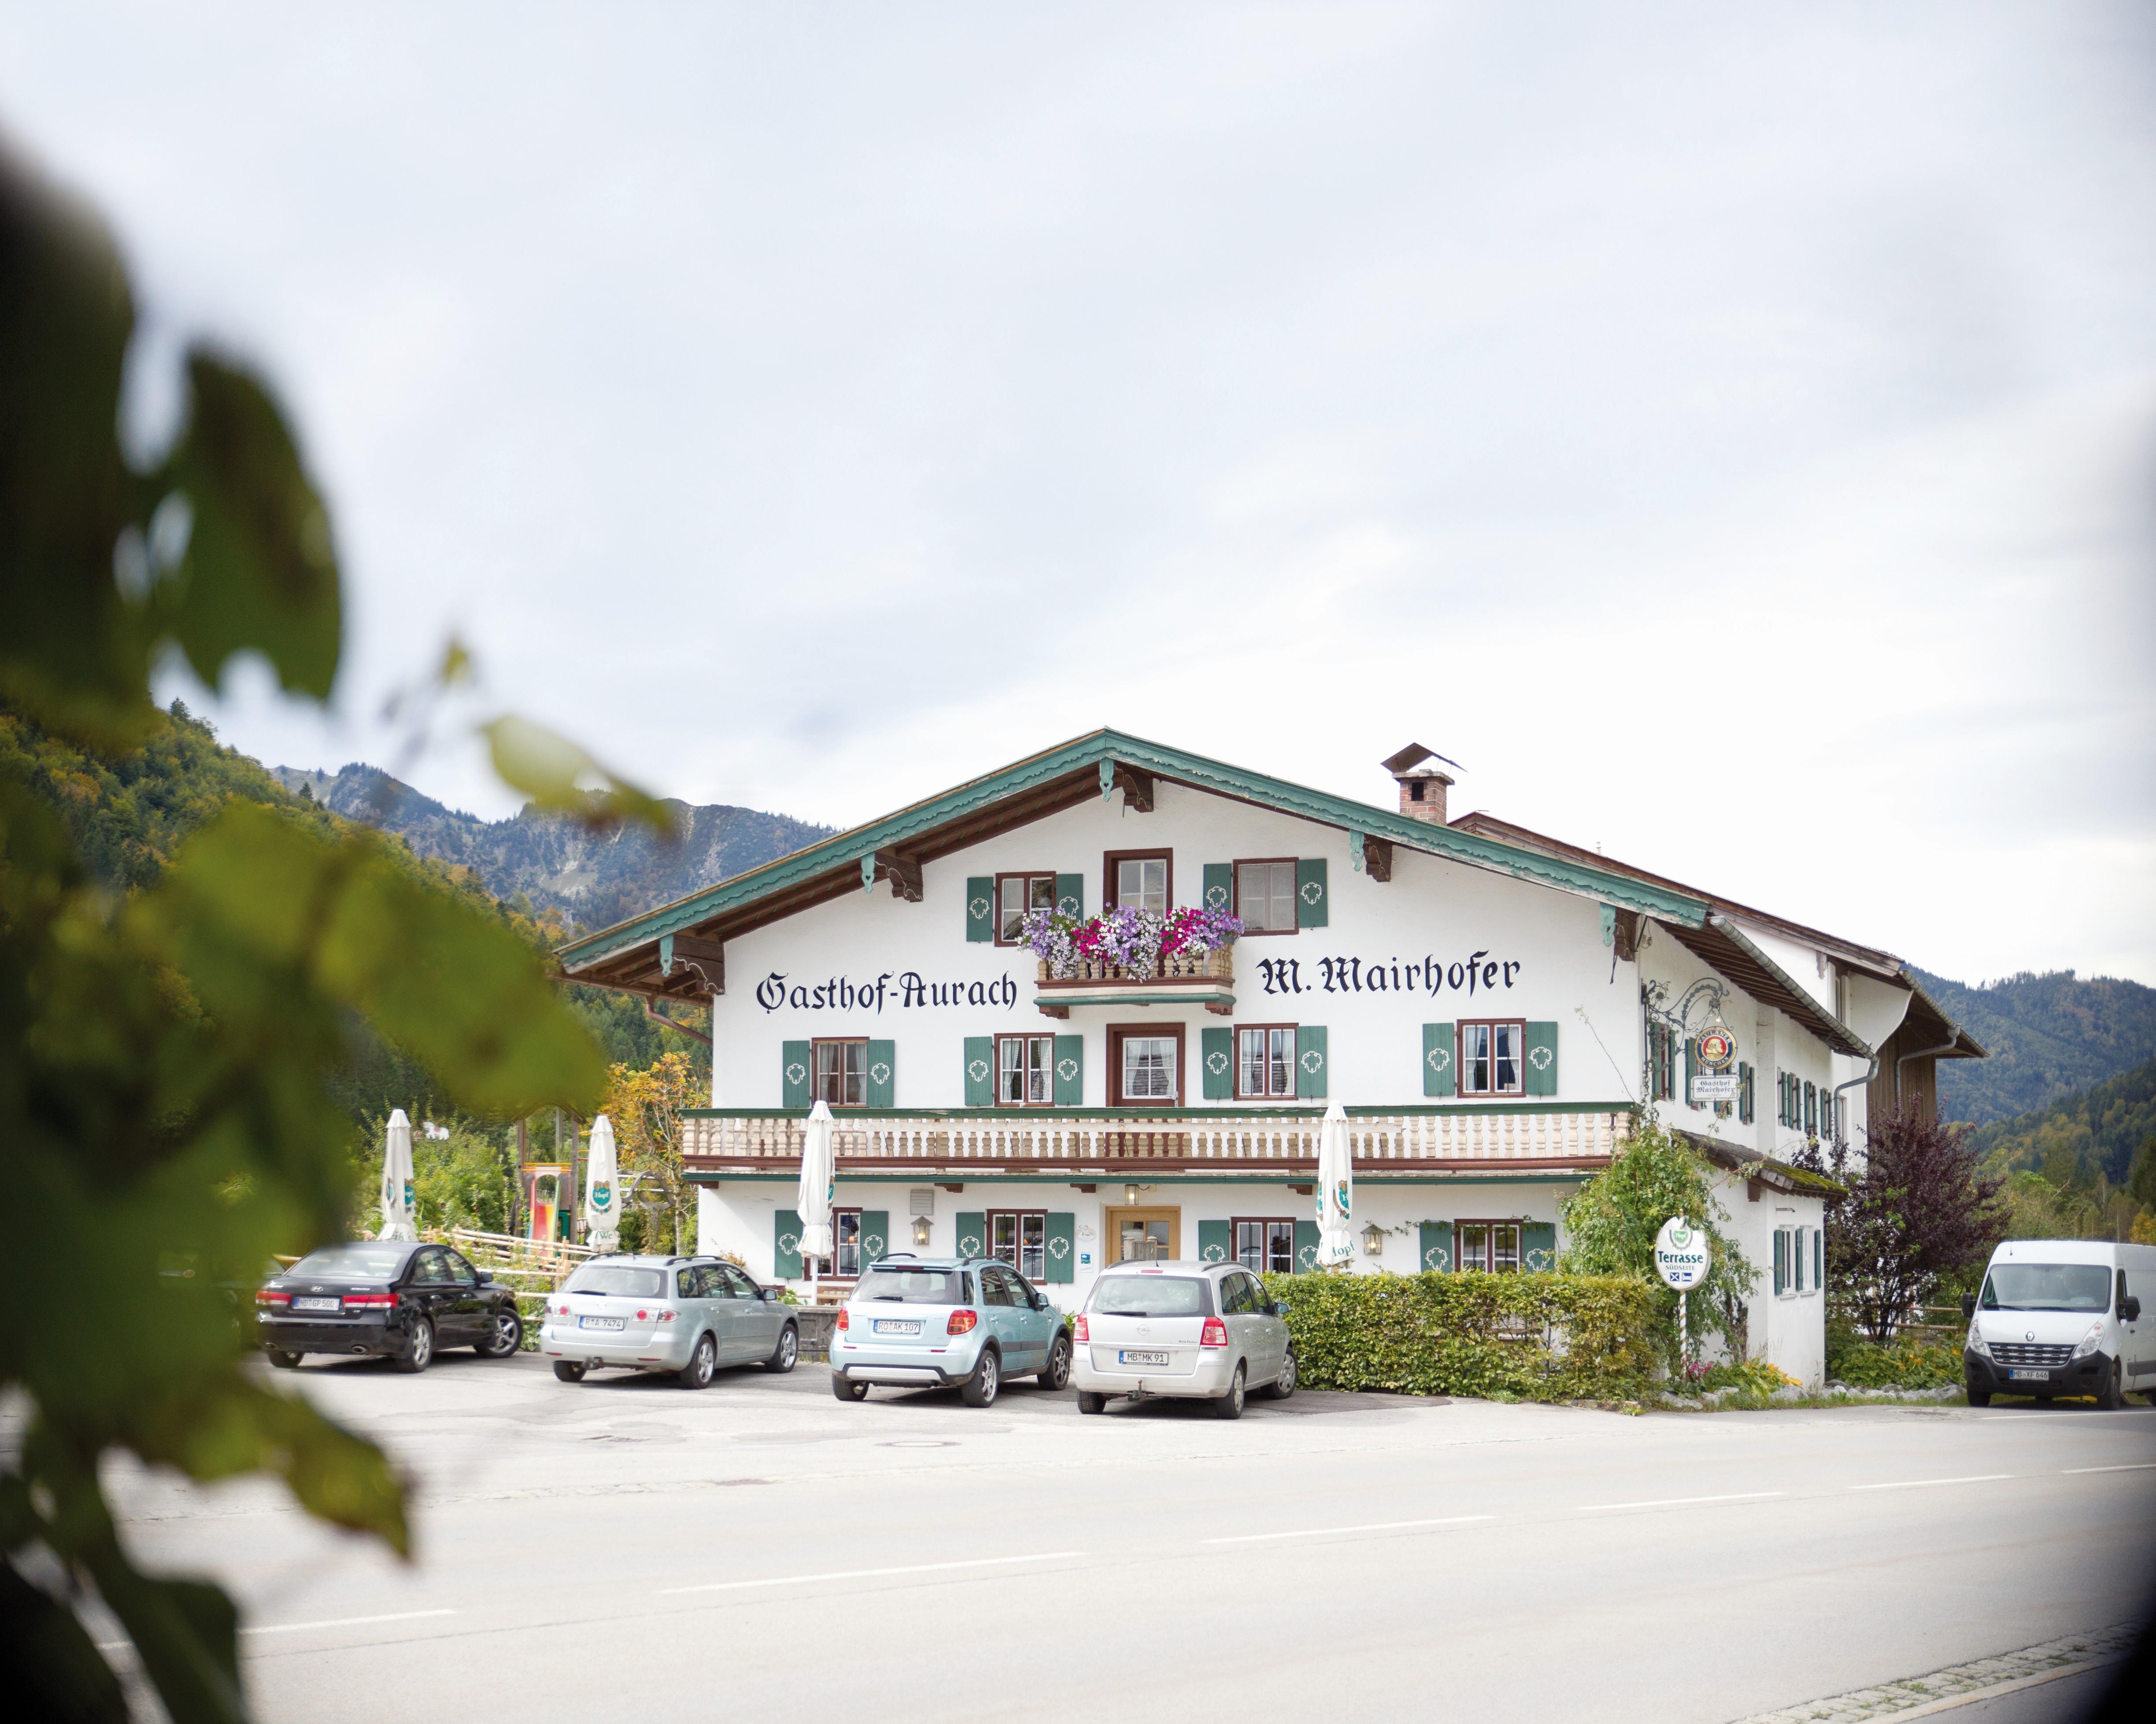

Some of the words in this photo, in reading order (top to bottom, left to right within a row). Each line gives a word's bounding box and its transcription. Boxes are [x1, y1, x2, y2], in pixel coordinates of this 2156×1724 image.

[1256, 958, 1311, 994] M.
[1317, 949, 1520, 998] Mairhofer
[756, 971, 1017, 1015] Gasthof-Aurach
[1698, 1030, 1732, 1044] PAULANER
[1657, 1251, 1703, 1263] Terrasse
[603, 1319, 621, 1328] 7474
[1127, 1353, 1138, 1361] MB
[1143, 1353, 1153, 1362] MK
